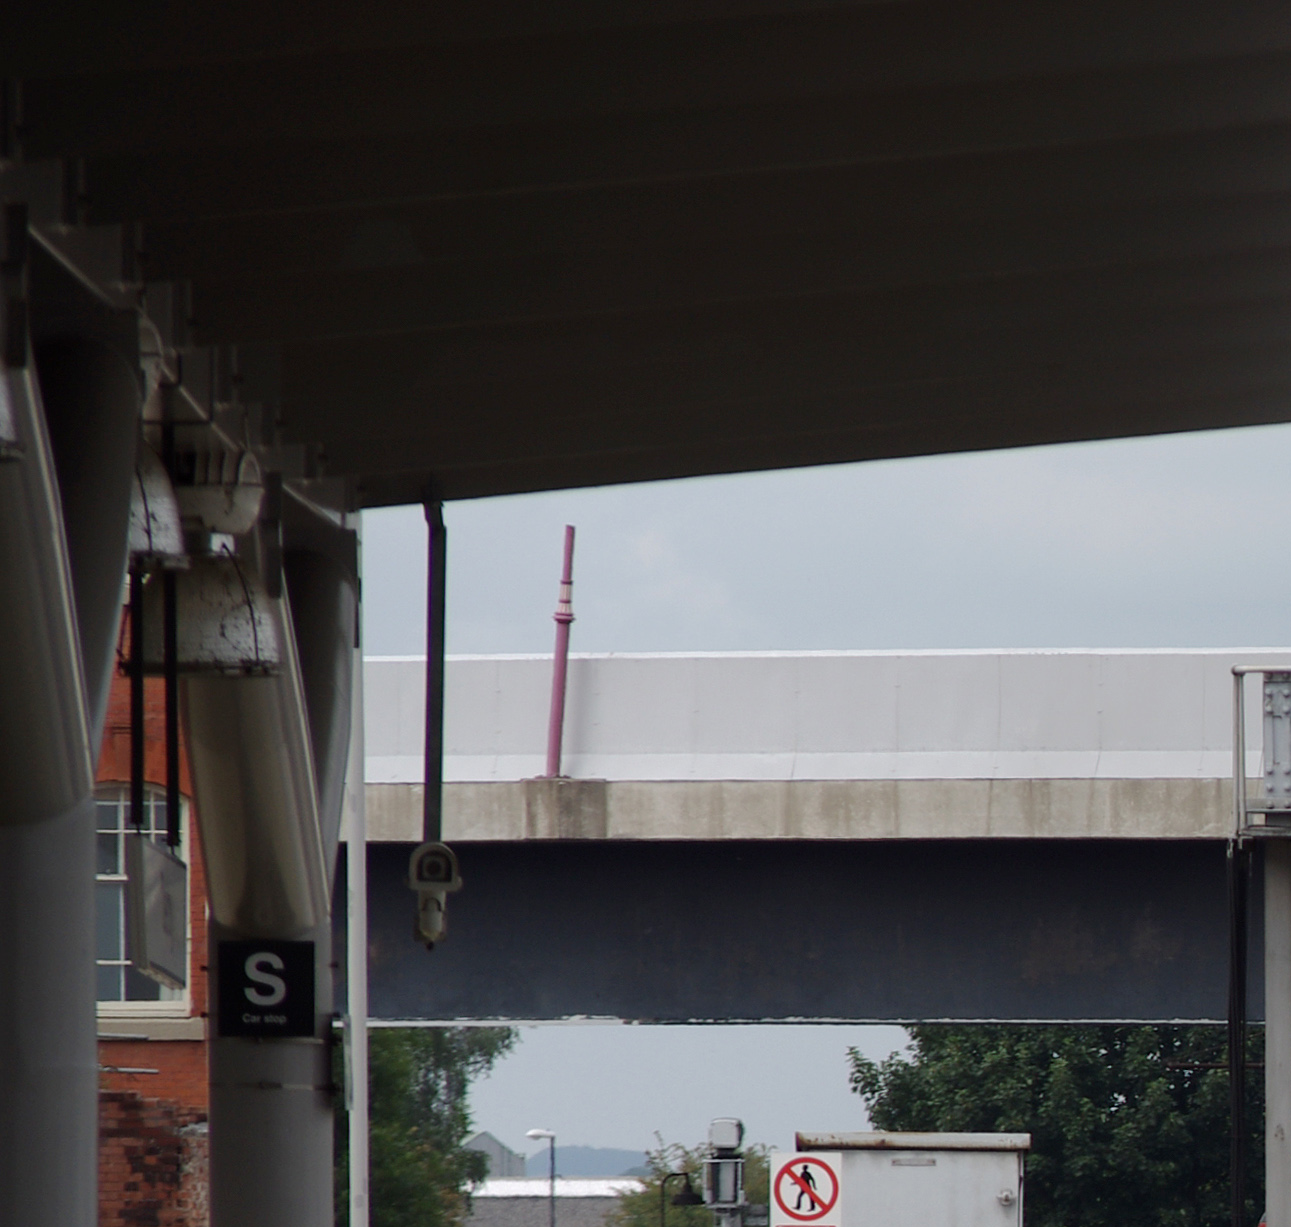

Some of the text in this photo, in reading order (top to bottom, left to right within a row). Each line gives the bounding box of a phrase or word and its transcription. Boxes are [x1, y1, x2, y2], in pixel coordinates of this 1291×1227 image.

[243, 952, 286, 1006] S
[242, 1013, 288, 1025] Car stop
